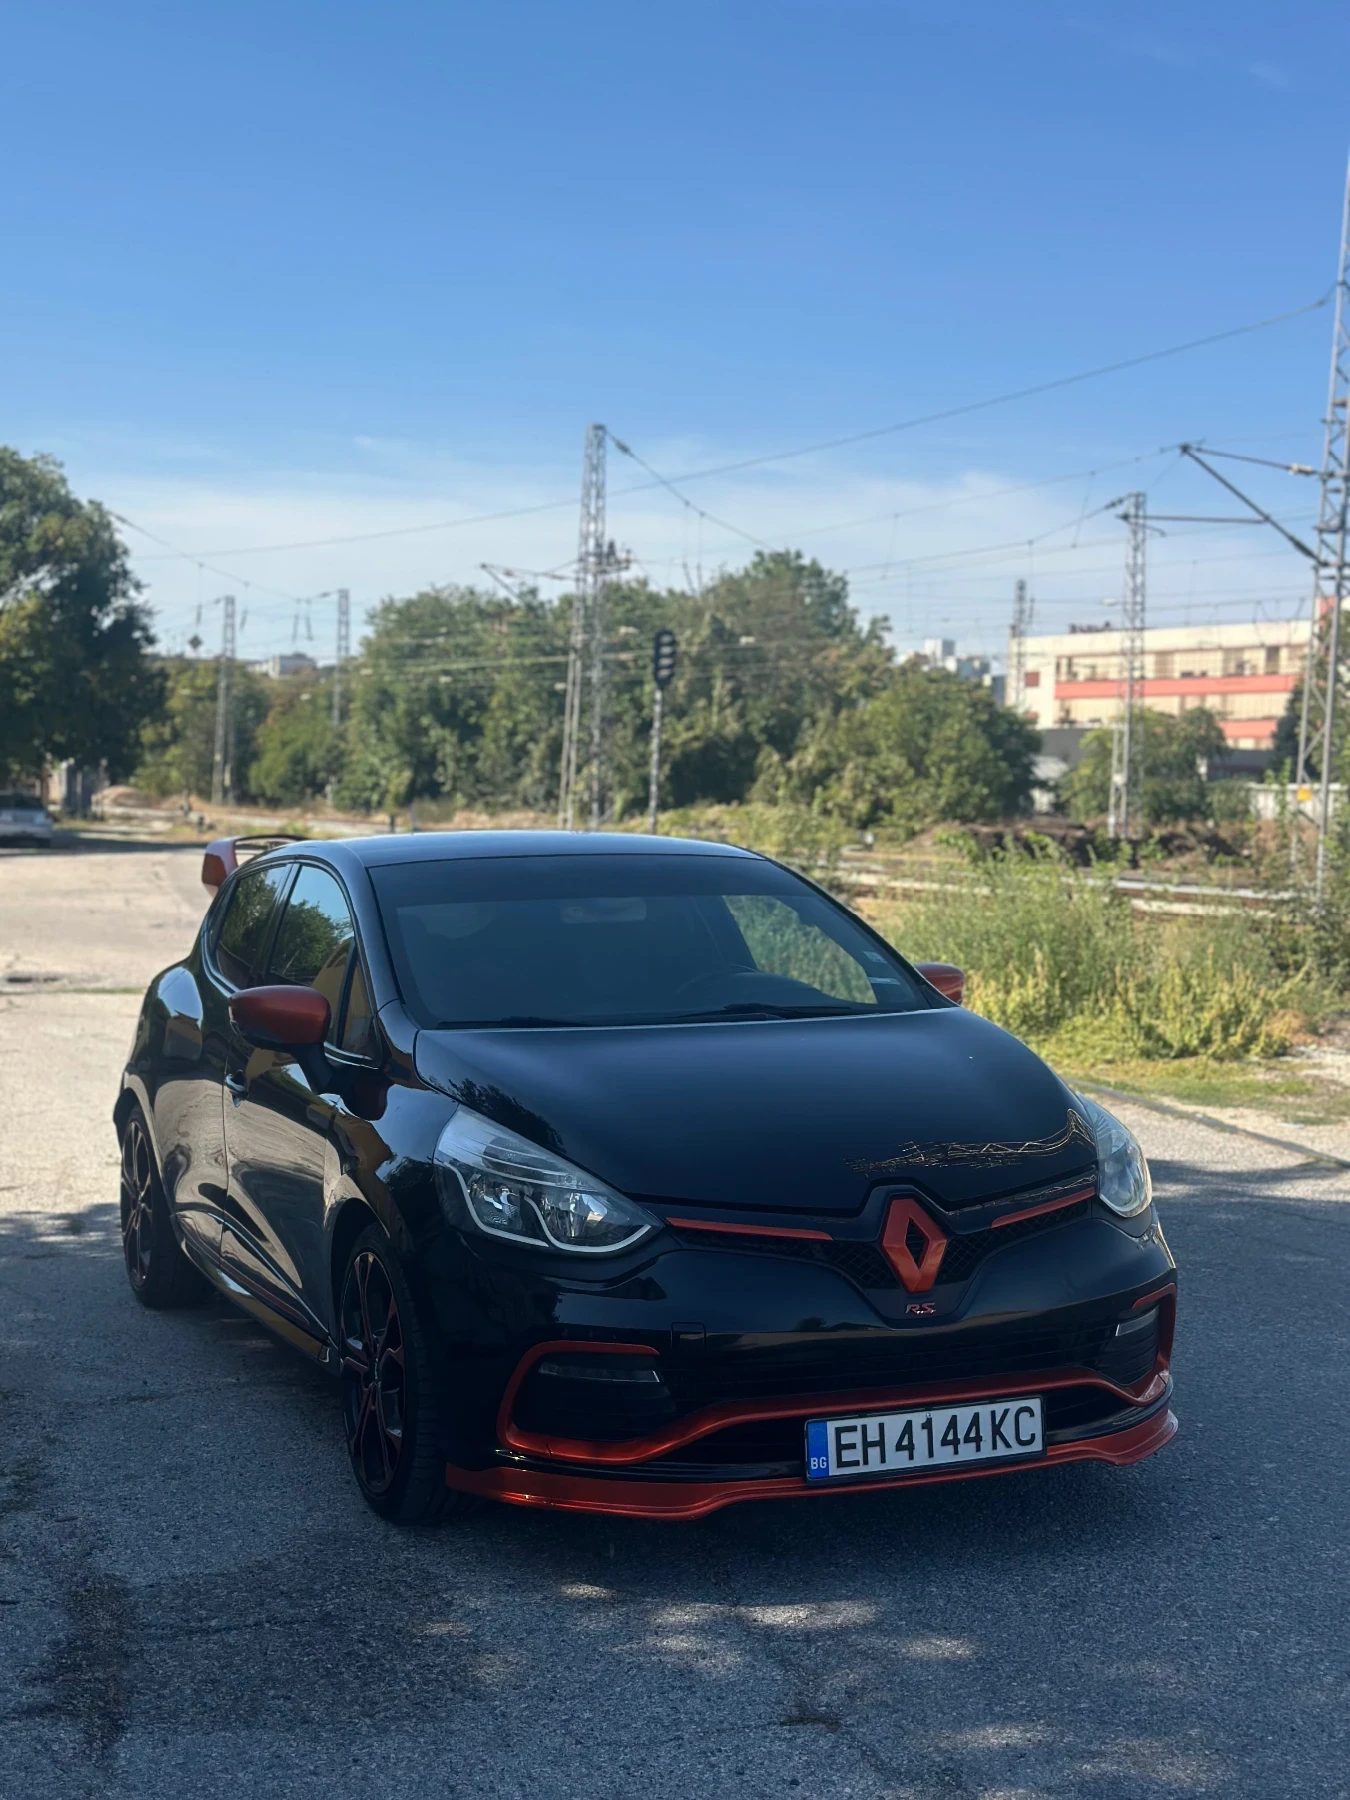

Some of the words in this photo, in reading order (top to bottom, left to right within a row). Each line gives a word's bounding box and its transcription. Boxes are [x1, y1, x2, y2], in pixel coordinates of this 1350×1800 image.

[835, 1422, 886, 1469] EH
[895, 1411, 983, 1461] 4144
[990, 1405, 1036, 1451] KC
[810, 1456, 828, 1470] BG
